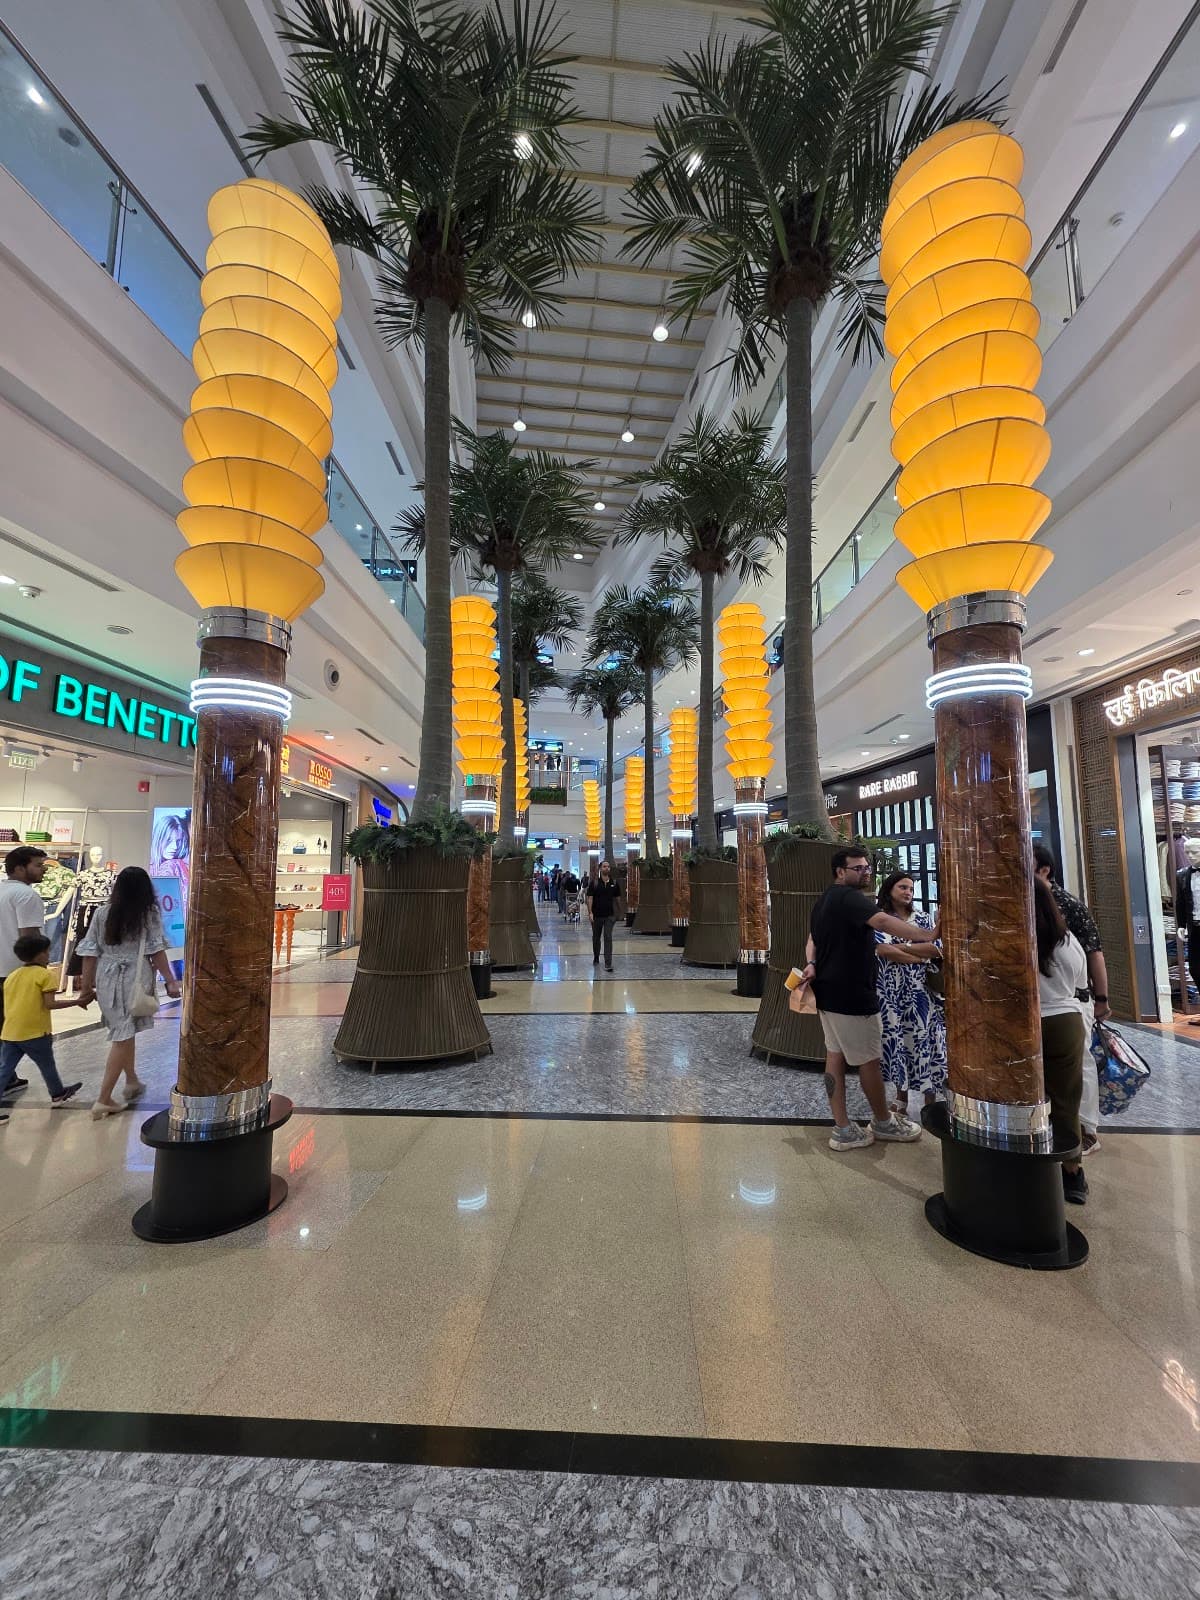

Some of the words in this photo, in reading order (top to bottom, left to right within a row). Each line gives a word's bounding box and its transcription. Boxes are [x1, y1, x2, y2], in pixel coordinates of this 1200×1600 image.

[310, 760, 333, 781] ROSSO
[859, 781, 883, 799] RARE
[883, 770, 919, 792] RABBIT
